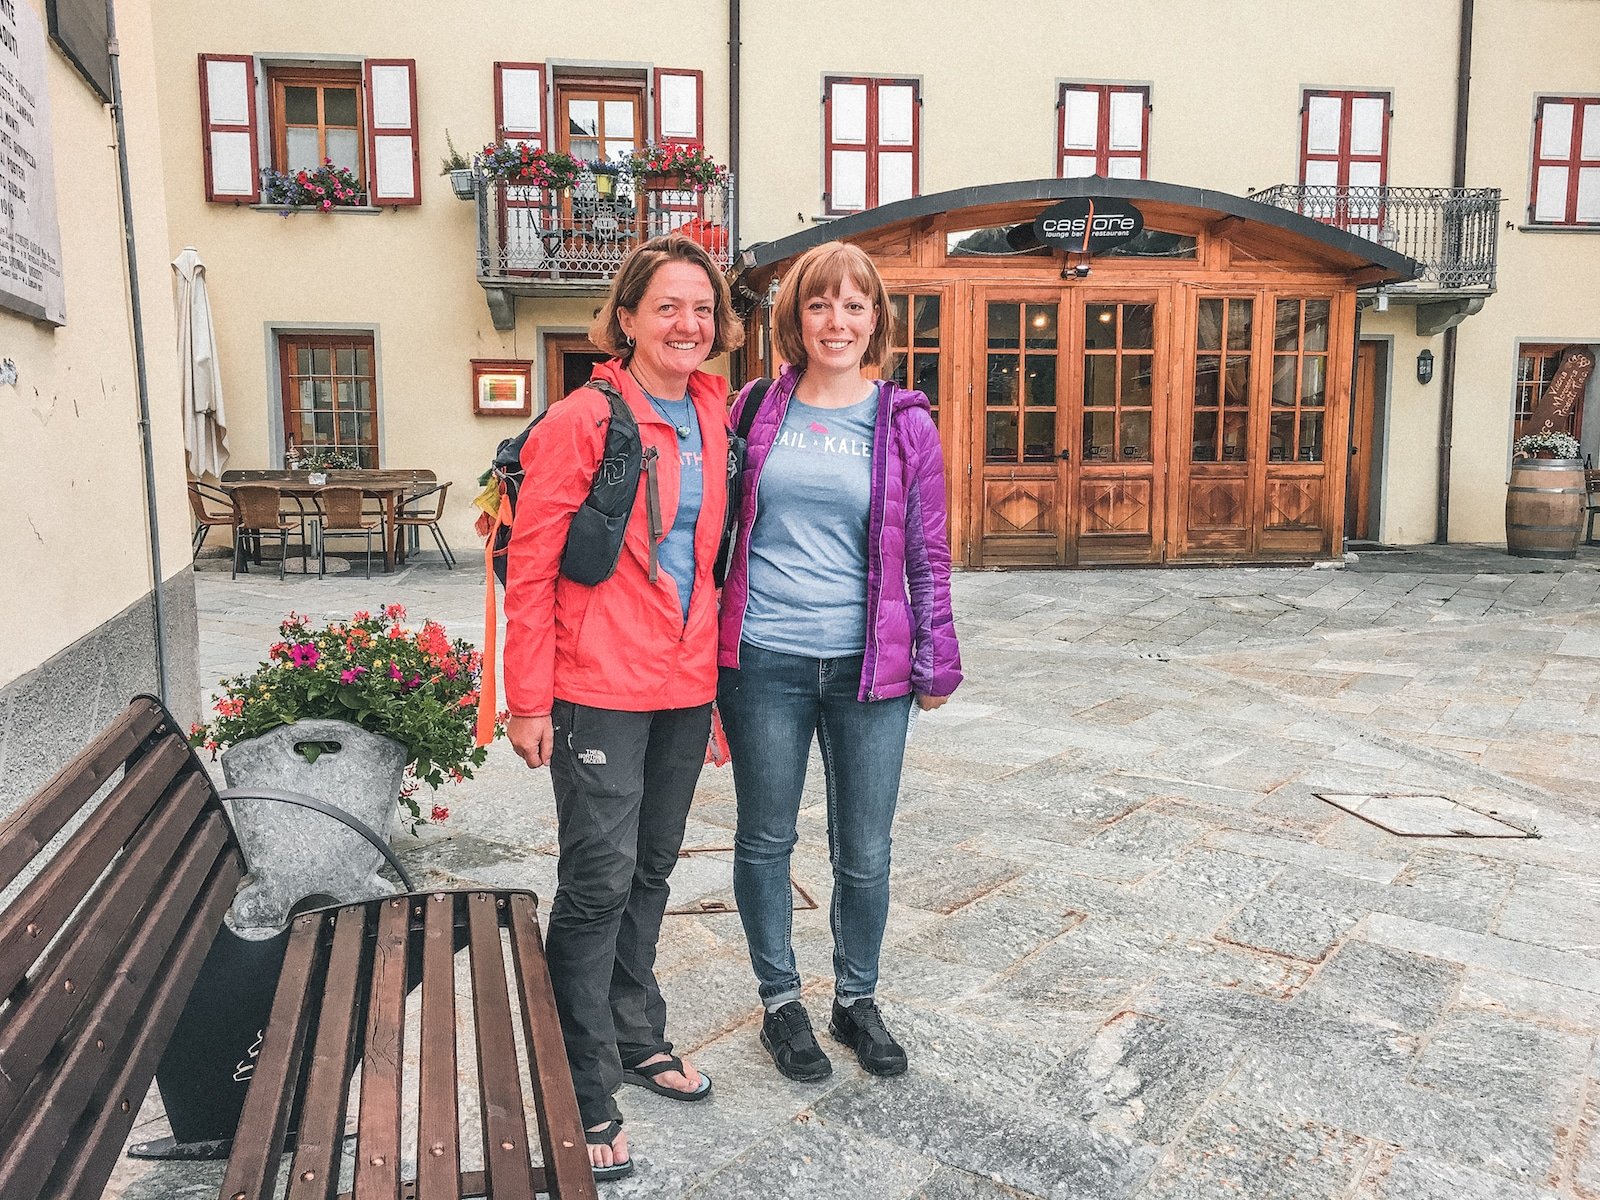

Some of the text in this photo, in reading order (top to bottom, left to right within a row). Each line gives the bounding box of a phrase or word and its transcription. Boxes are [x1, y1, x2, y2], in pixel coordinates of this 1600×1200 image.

[1043, 213, 1135, 232] castore
[1045, 231, 1070, 239] lounge
[824, 436, 871, 458] KALE
